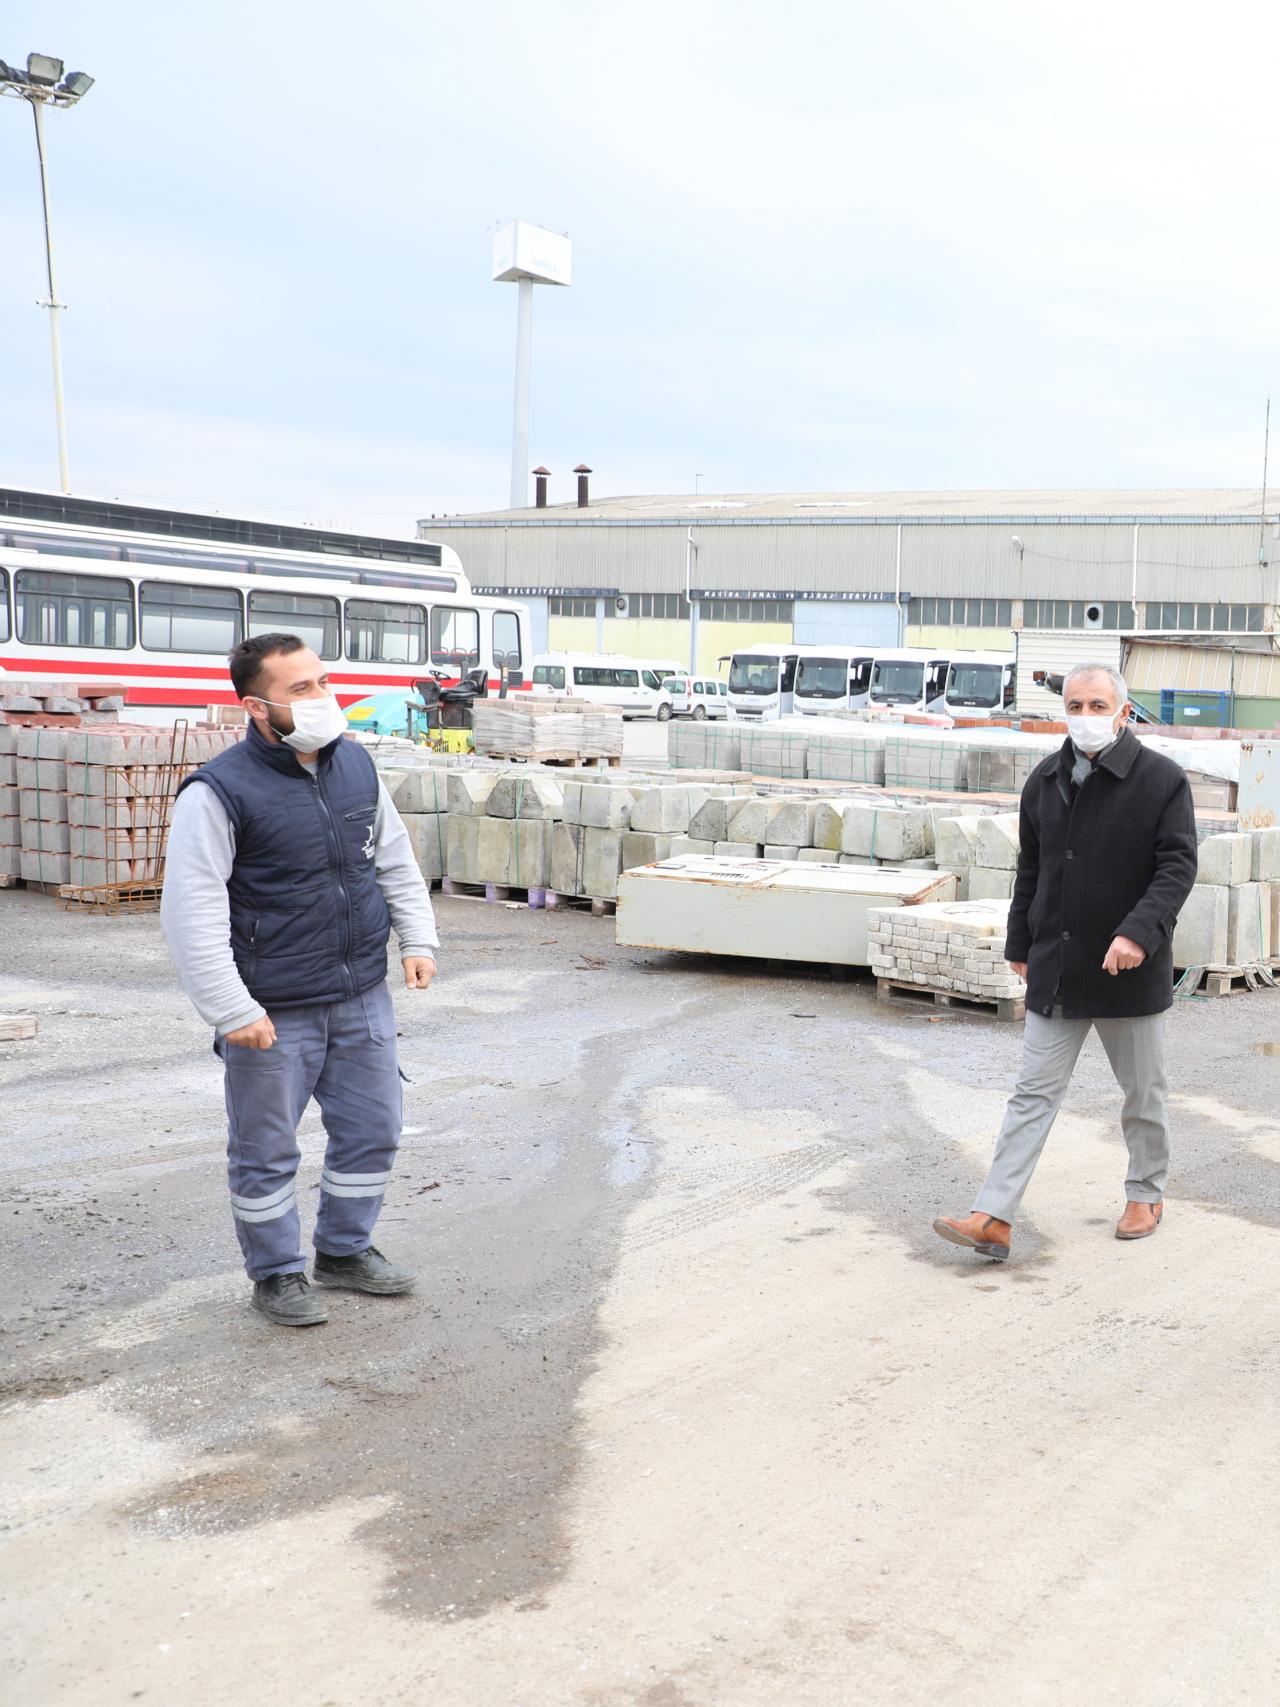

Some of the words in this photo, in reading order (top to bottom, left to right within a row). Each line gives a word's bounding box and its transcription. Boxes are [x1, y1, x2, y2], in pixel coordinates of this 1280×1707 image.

[471, 587, 500, 595] ARICA
[507, 586, 564, 595] BELEDİYESİ
[747, 590, 777, 599] İKMAL
[803, 592, 833, 600] GARAJ
[842, 591, 883, 600] SERVİSİ
